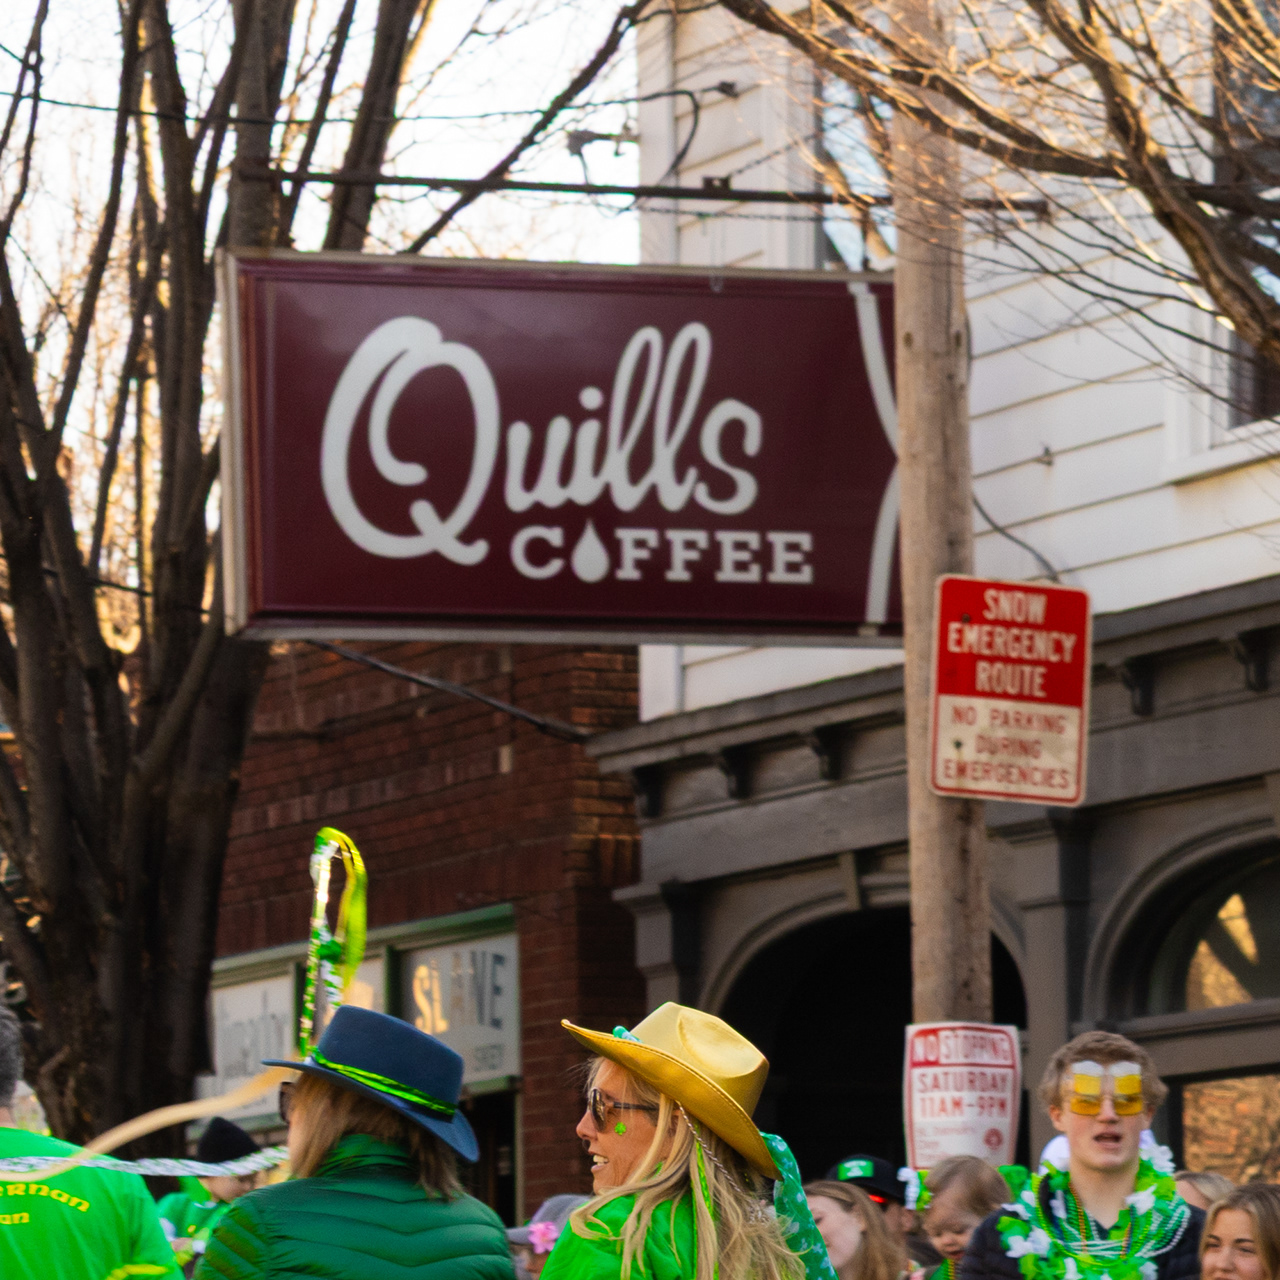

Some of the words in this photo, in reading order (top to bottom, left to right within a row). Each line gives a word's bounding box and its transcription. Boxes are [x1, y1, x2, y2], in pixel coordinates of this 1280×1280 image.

[321, 316, 763, 566] Quills
[510, 520, 813, 584] COFFEE
[983, 588, 1048, 625] SNOW
[947, 622, 1077, 664] EMERGENCY
[975, 661, 1048, 698] ROUTE
[951, 705, 977, 726] NO
[989, 708, 1067, 735] PARKING
[975, 735, 1042, 760] DURING
[943, 758, 1070, 790] EMERGENCIES
[913, 1035, 938, 1061] NO
[943, 1033, 1010, 1062] STOPPING
[918, 1072, 1009, 1093] SATURDAY
